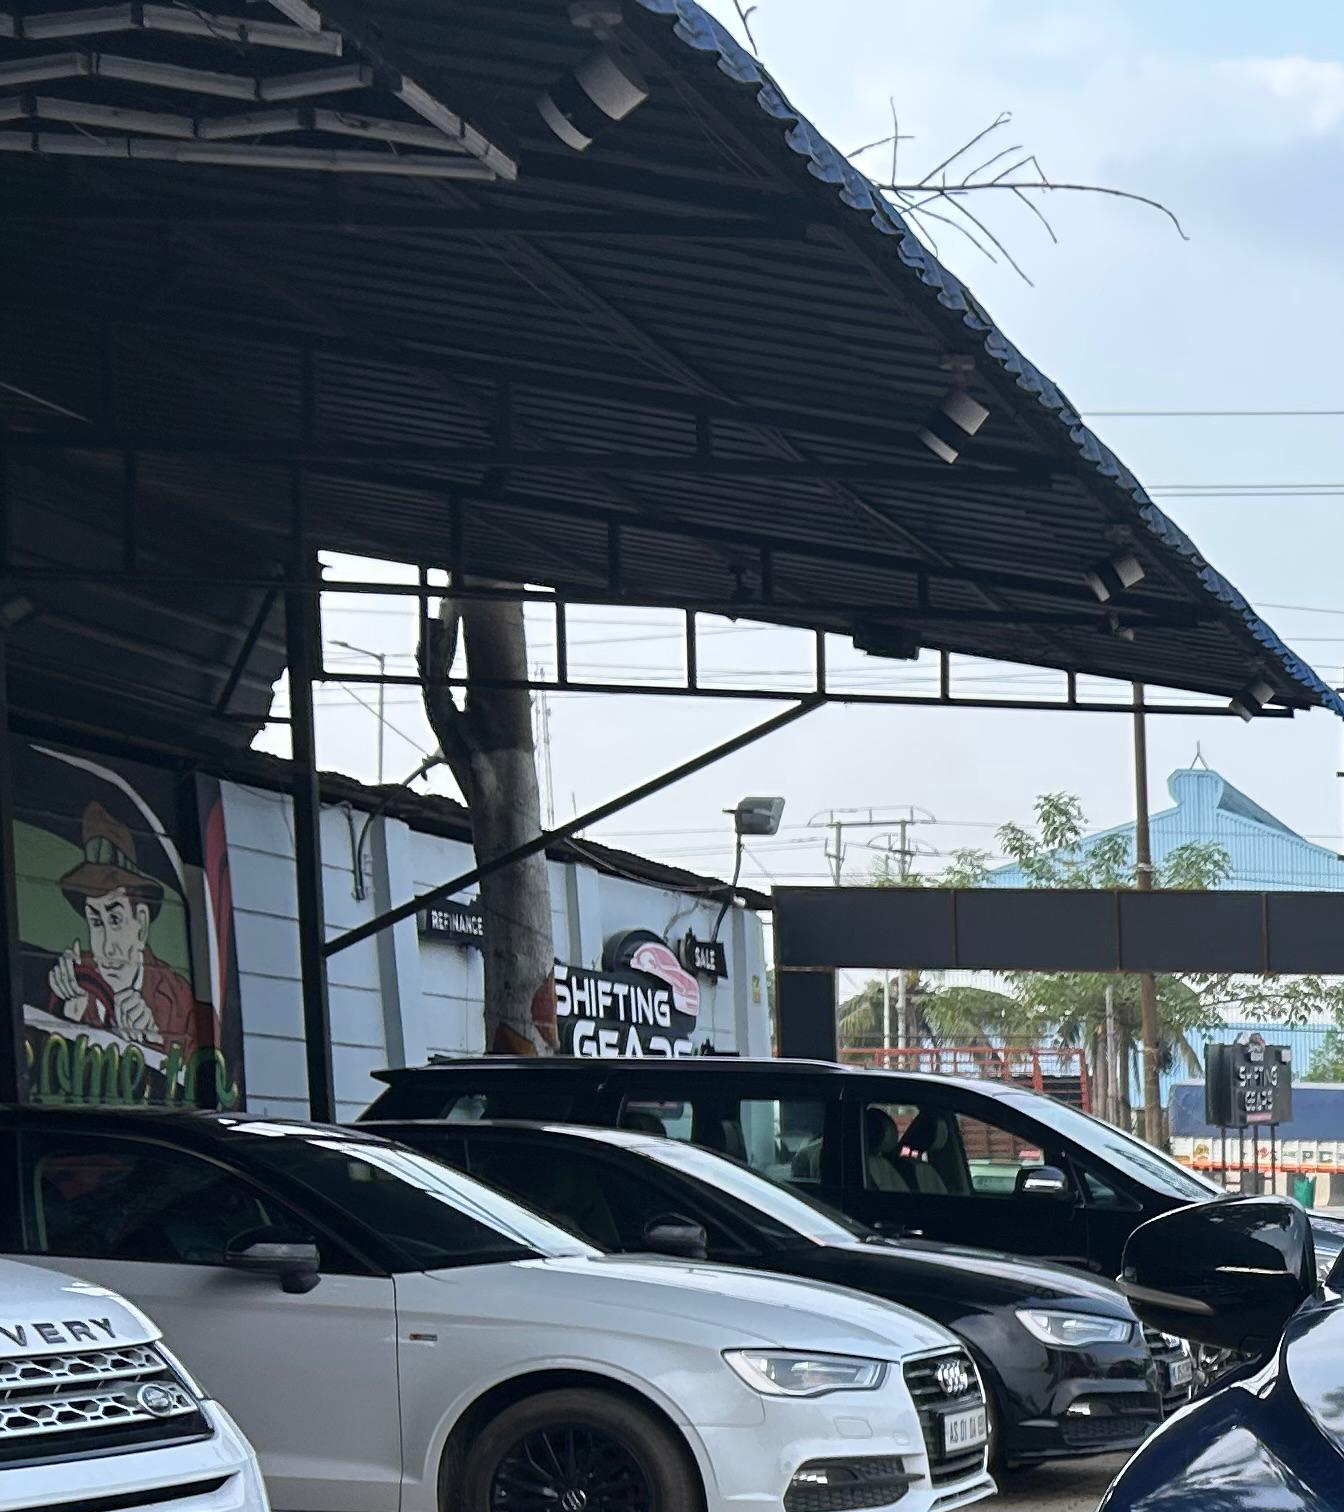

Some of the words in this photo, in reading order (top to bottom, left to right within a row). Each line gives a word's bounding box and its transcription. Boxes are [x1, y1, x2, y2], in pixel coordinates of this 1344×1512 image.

[694, 947, 717, 971] SALE
[554, 964, 671, 1027] SHIFTING
[0, 1317, 117, 1347] VERY
